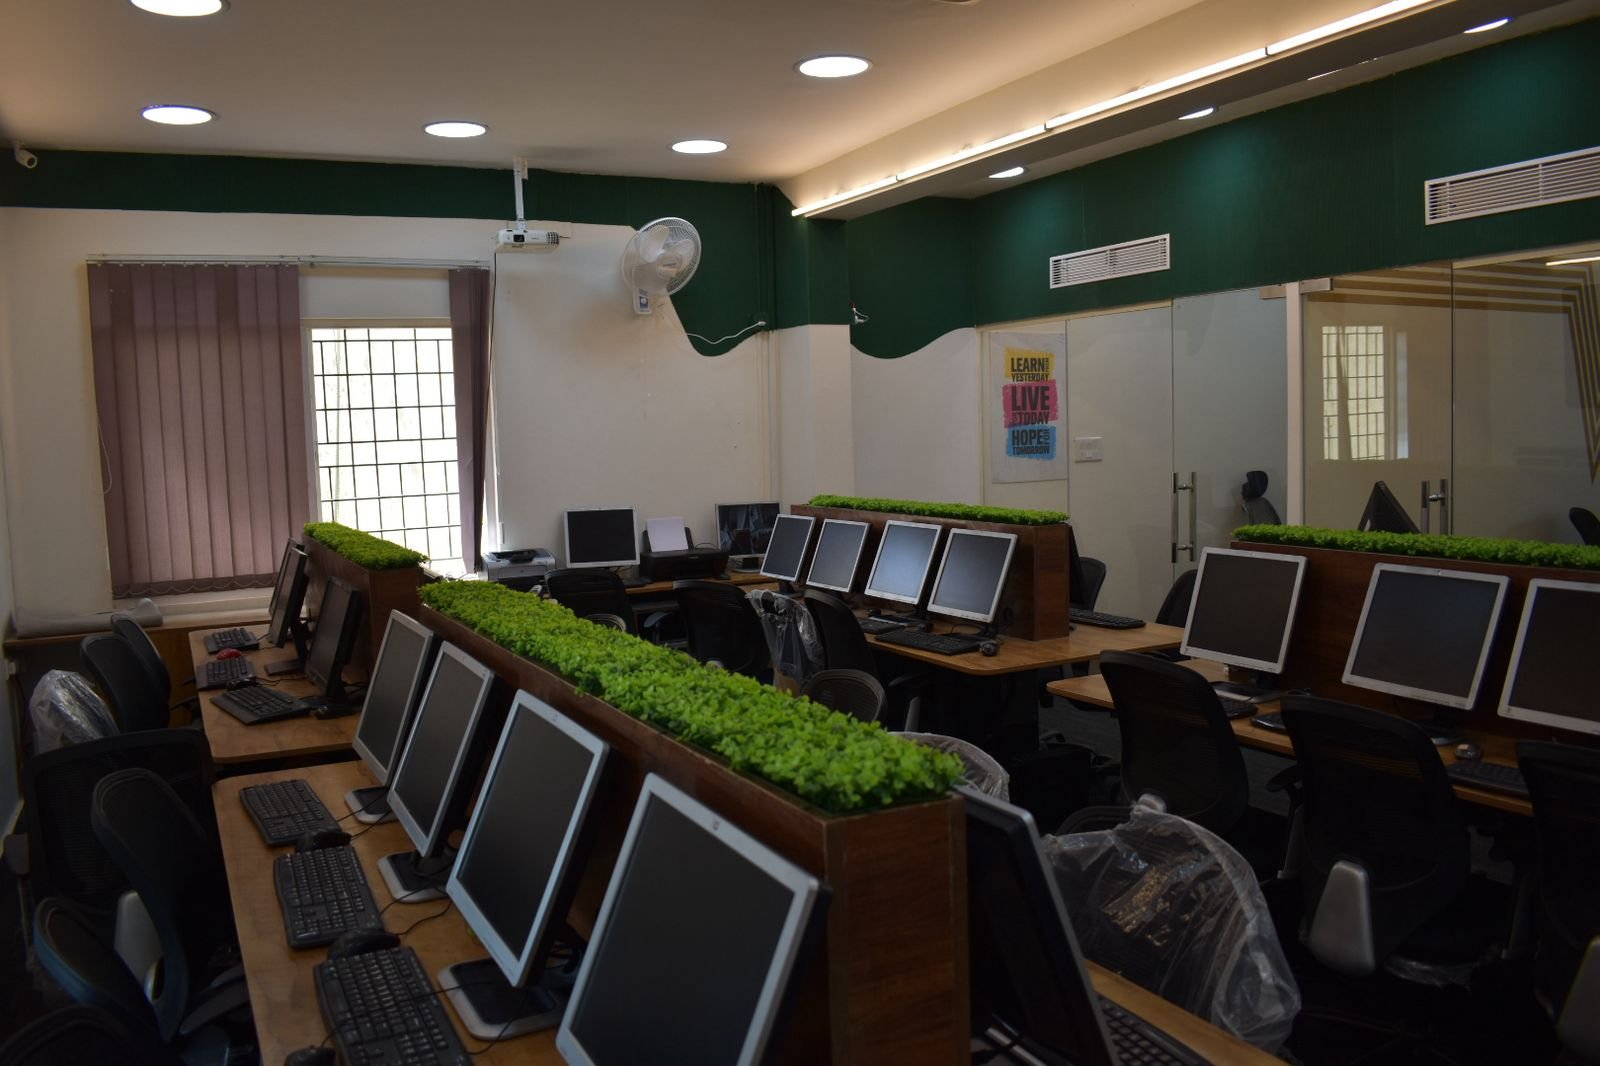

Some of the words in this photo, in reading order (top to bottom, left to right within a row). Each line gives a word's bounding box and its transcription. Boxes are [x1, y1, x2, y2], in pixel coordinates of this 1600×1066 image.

[1011, 357, 1045, 372] LEARN
[1011, 372, 1049, 382] YESTERDAY
[1011, 386, 1050, 411] LIVE
[1018, 411, 1050, 425] TODAY
[1012, 429, 1043, 445] HOPE
[1012, 445, 1050, 456] TOMORROW
